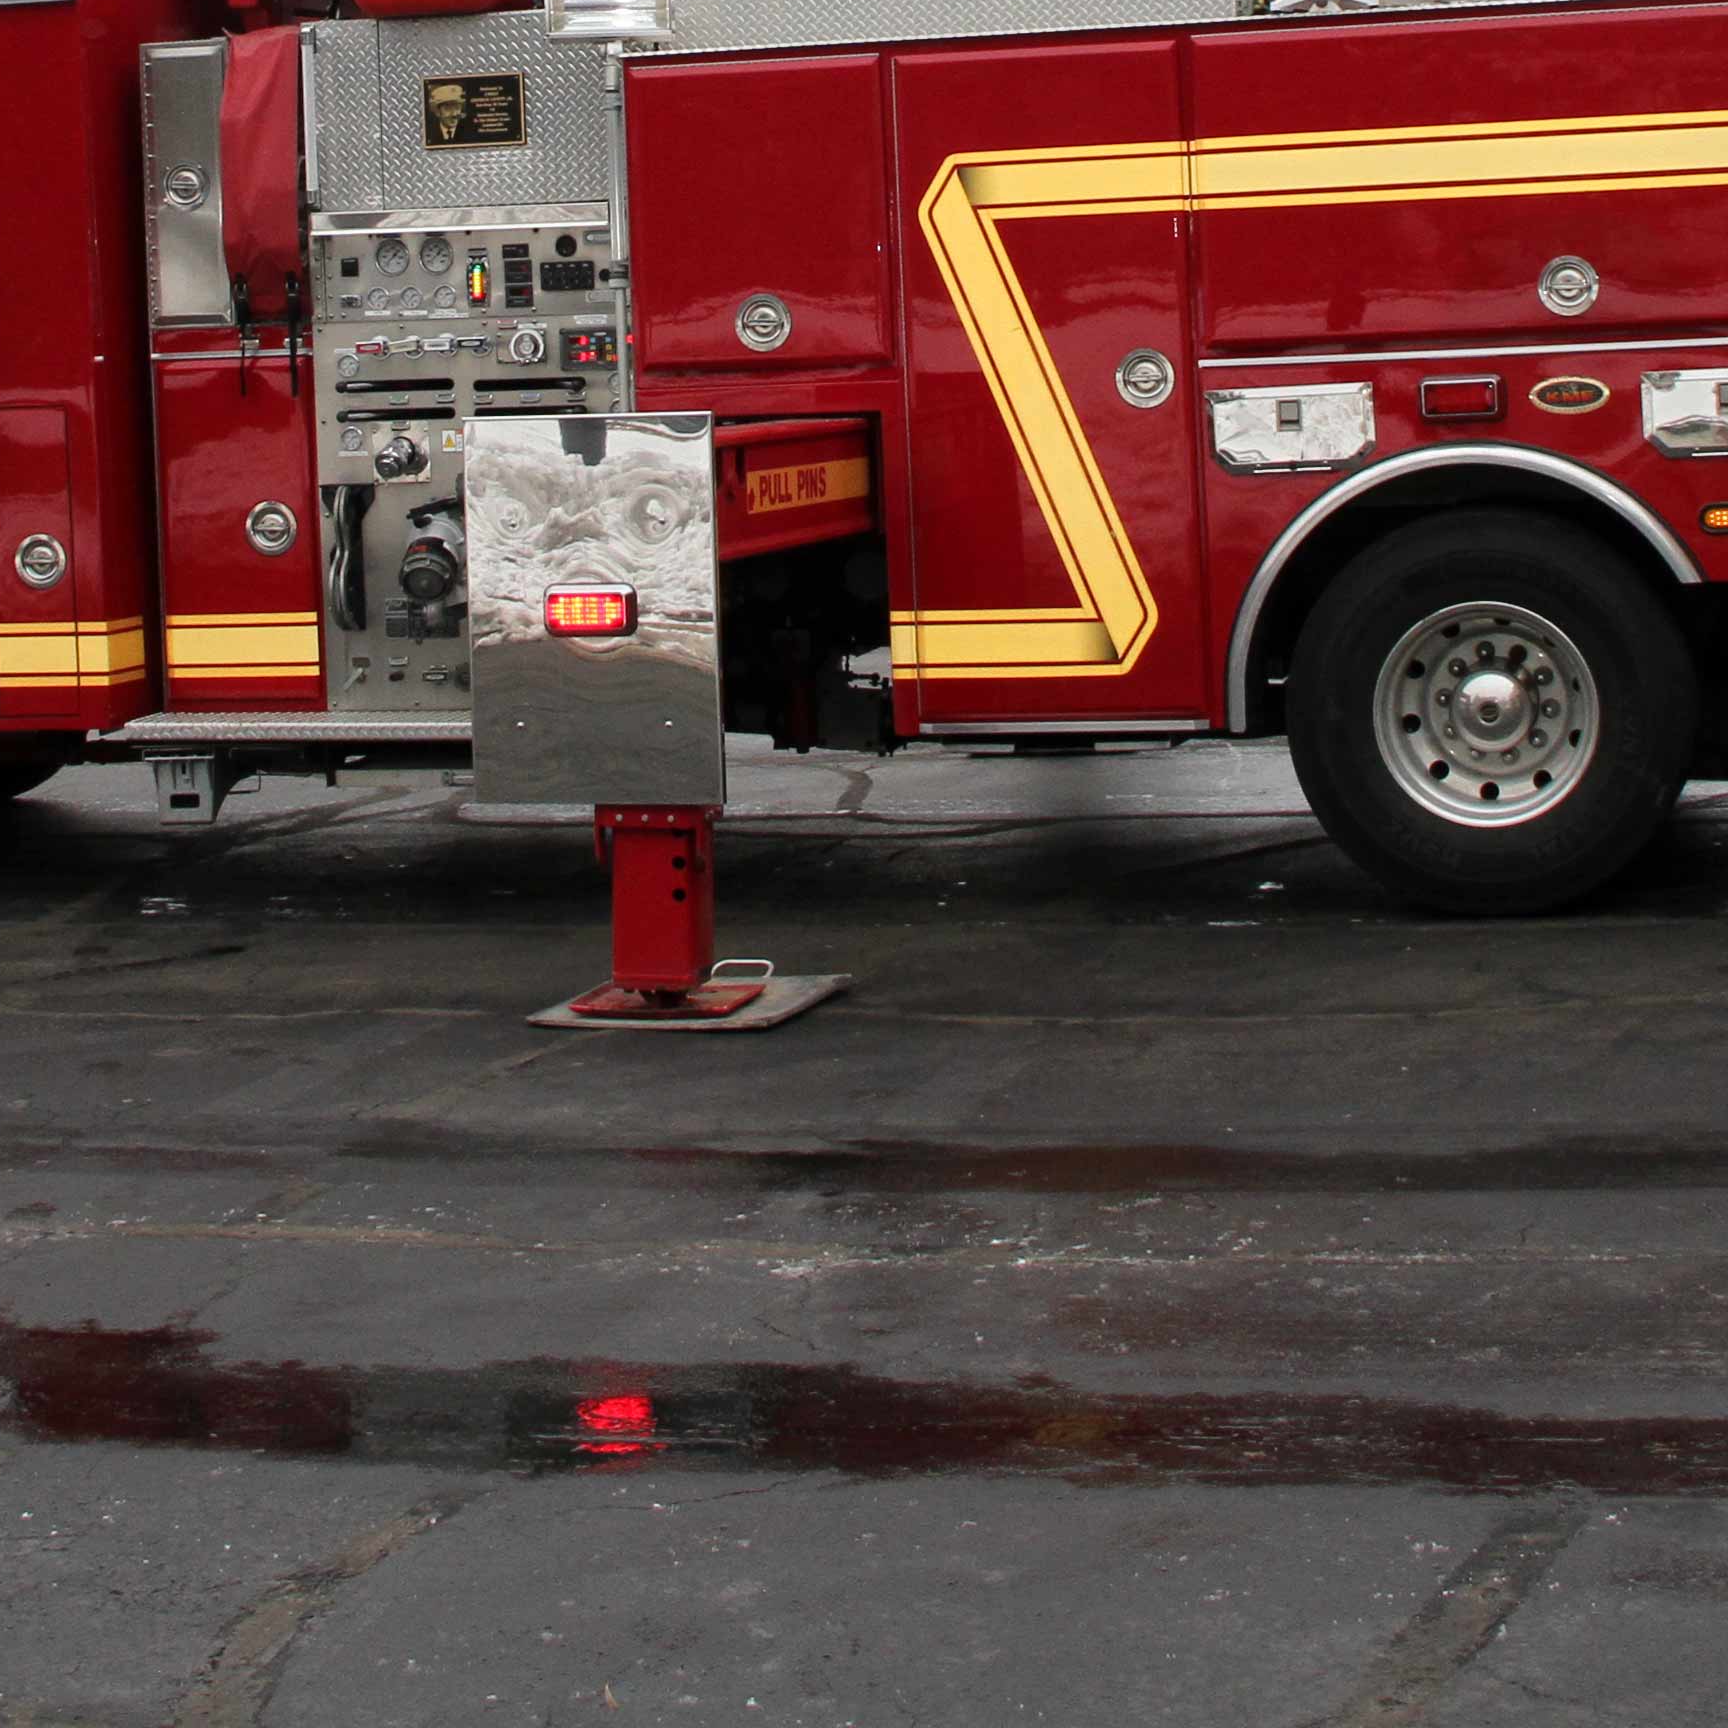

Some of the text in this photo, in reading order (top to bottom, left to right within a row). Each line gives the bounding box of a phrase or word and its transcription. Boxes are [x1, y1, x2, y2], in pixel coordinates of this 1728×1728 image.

[1546, 389, 1594, 402] KME
[759, 466, 827, 507] PULL PINS
